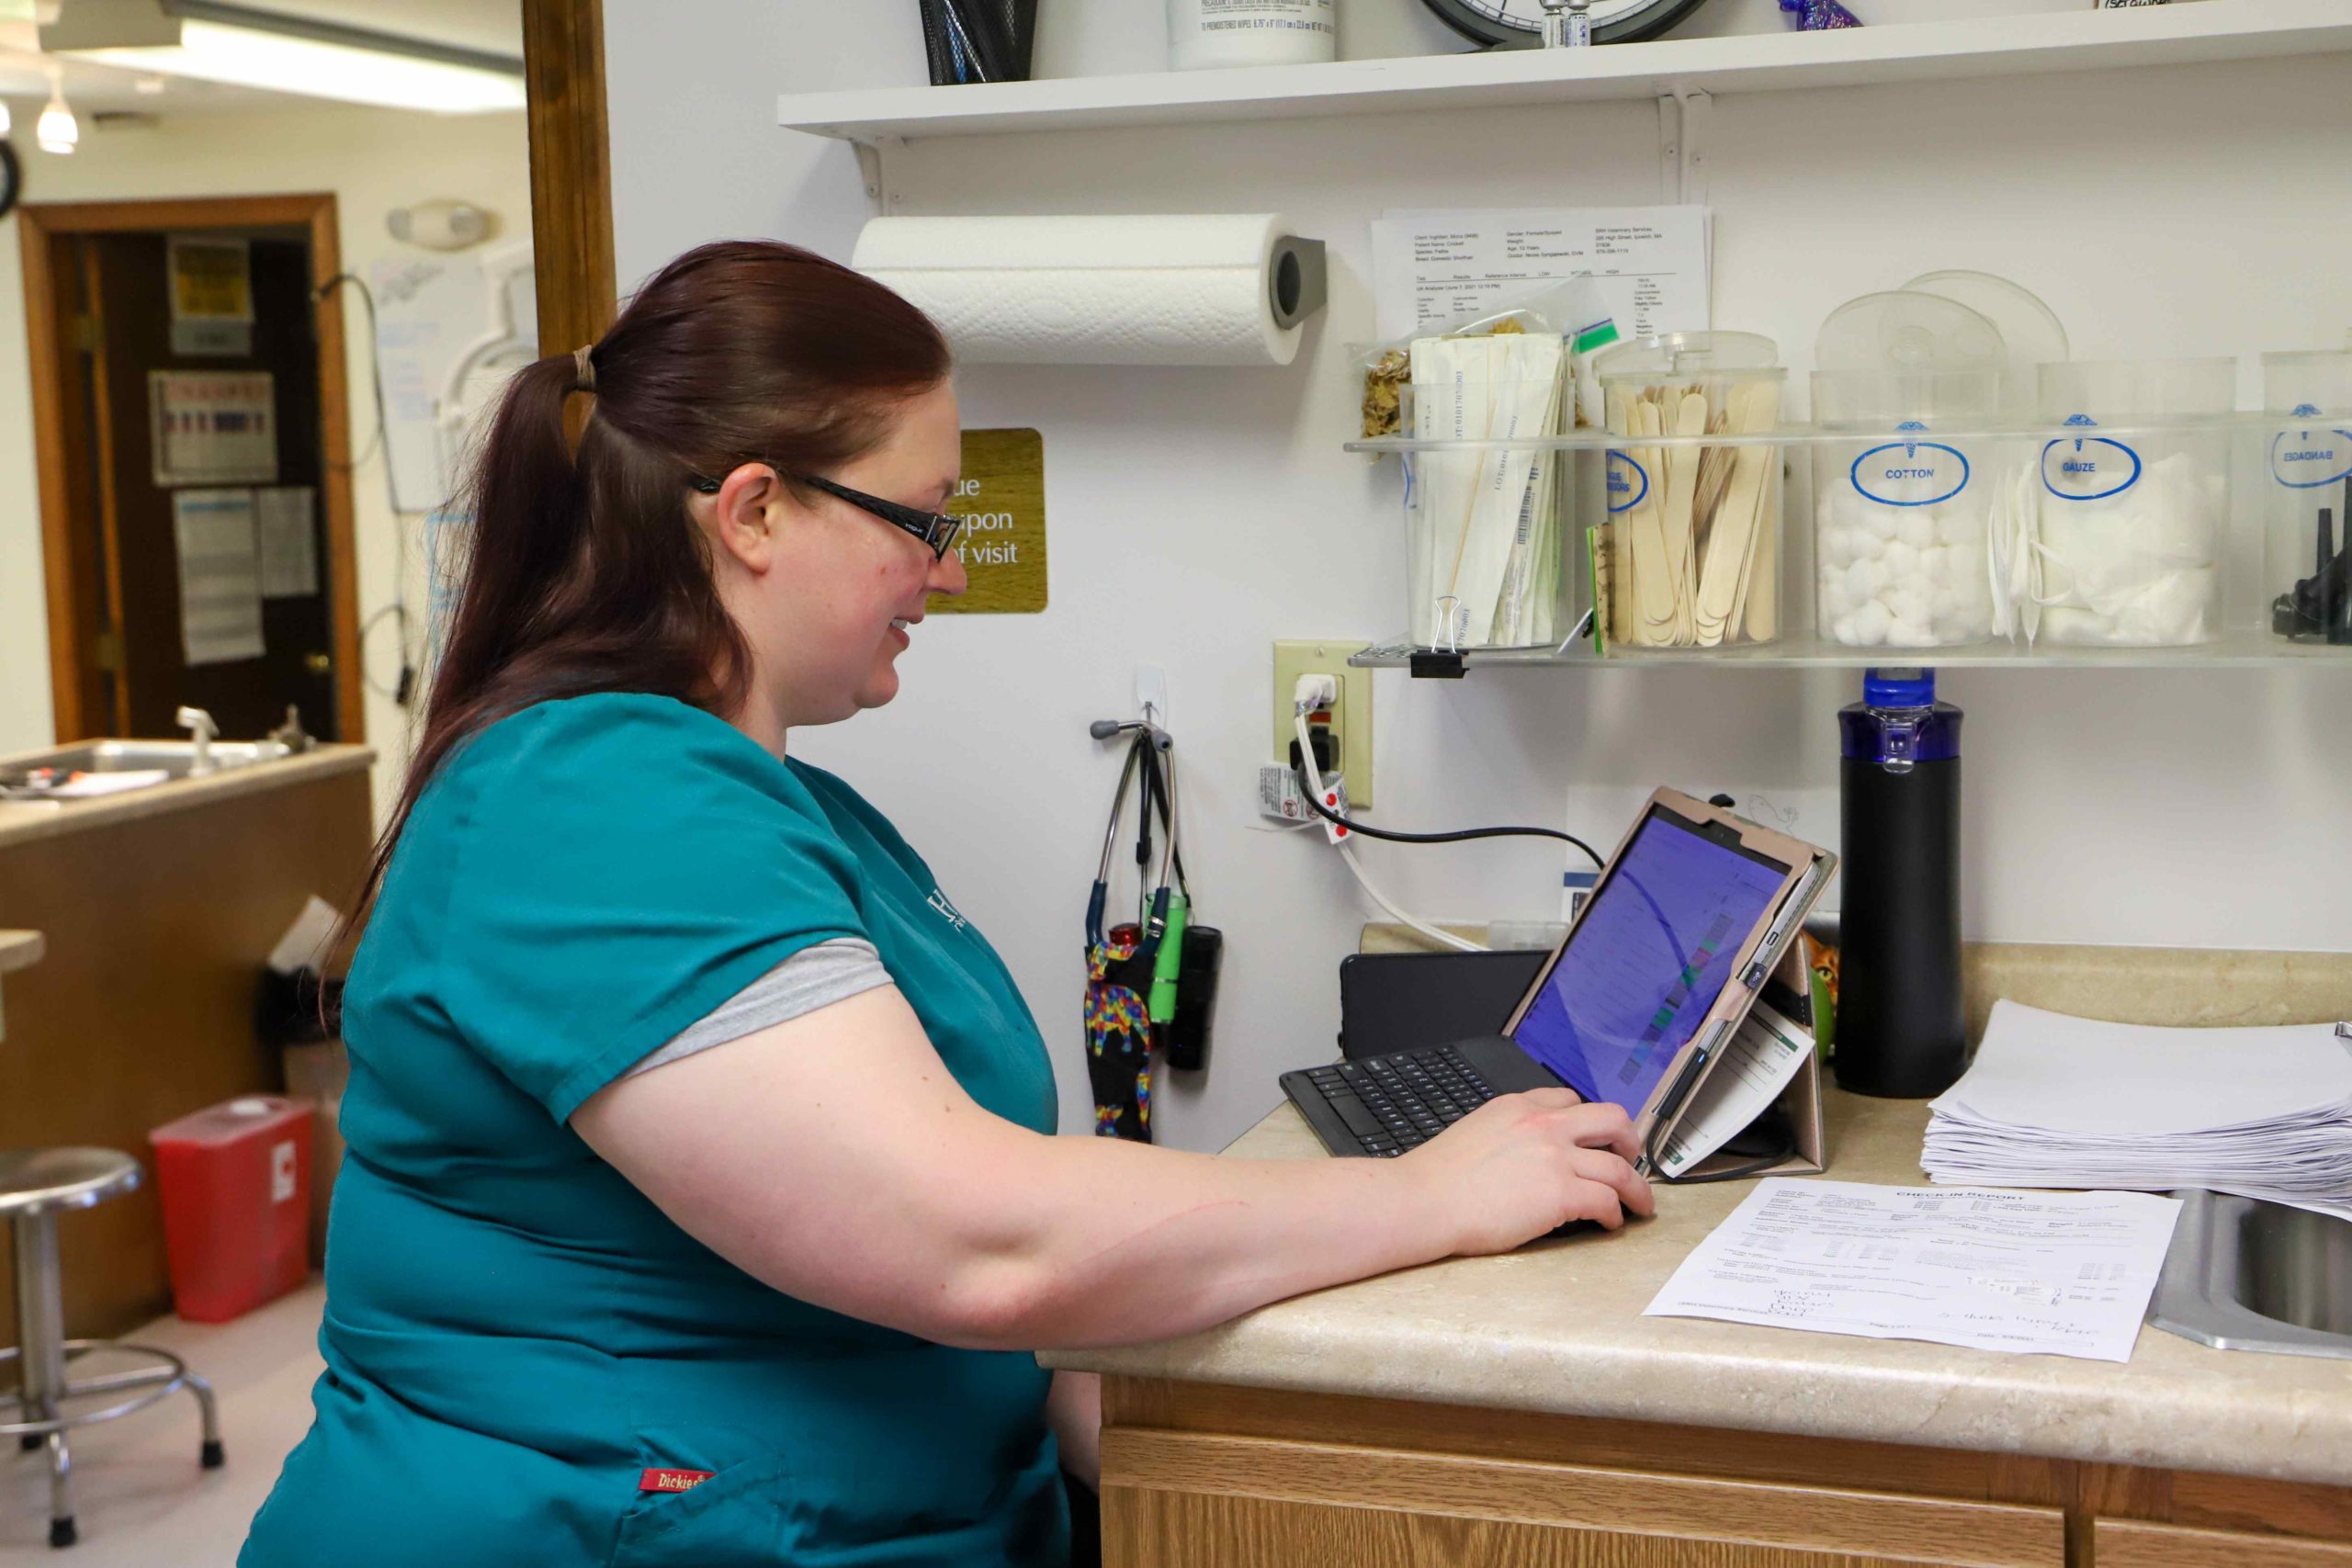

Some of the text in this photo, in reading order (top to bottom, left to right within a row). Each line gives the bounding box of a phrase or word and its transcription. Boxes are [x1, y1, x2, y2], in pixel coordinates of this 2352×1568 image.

[2063, 462, 2096, 472] GAUZE
[1885, 468, 1935, 479] COTTON
[954, 479, 980, 496] ue
[972, 541, 1019, 564] visit
[1967, 1192, 2025, 1201] REPORT
